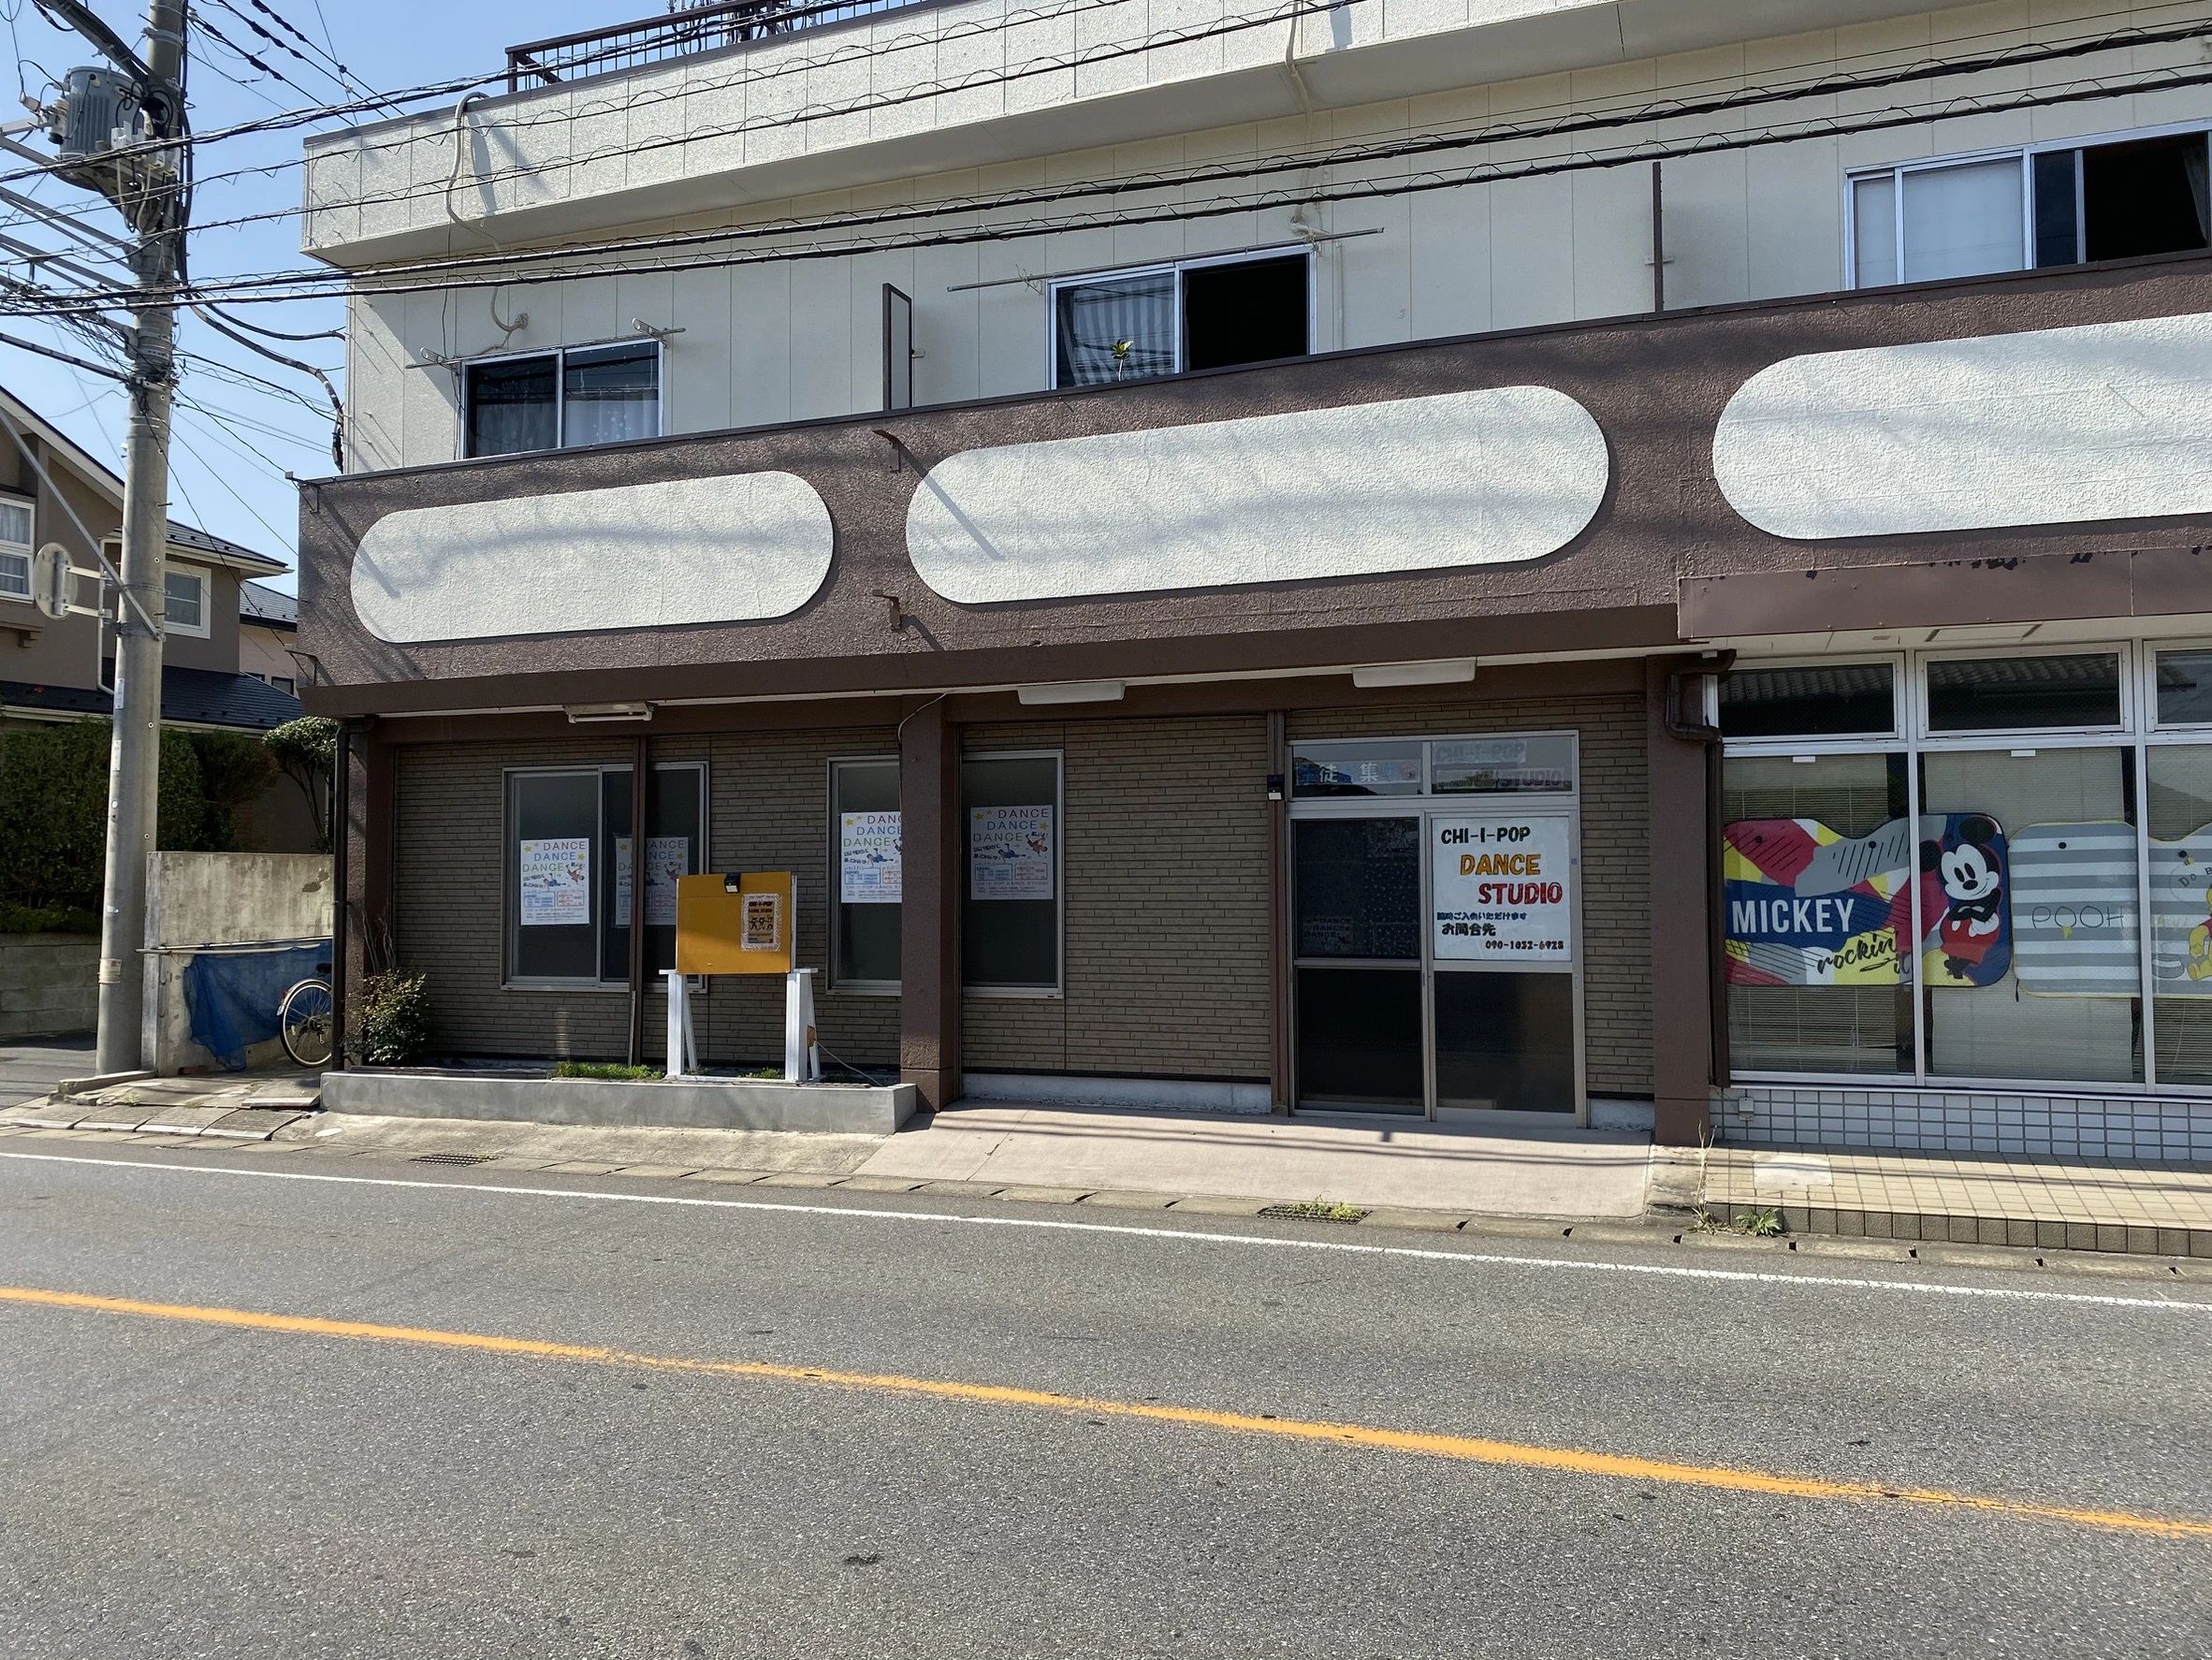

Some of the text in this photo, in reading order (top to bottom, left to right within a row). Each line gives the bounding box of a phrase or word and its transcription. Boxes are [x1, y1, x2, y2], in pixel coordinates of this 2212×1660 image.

[998, 808, 1049, 819] DANCE
[987, 820, 1039, 831] DANCE
[973, 832, 1023, 842] DANCE
[1440, 826, 1532, 845] CHI-I-POP
[543, 840, 586, 852] DANCE
[649, 839, 685, 850] ANCE
[843, 837, 891, 848] DANCE
[533, 852, 576, 862] DANCE
[522, 862, 565, 873] DANCE
[1460, 853, 1542, 877] DANCE
[1477, 881, 1564, 906] STUDIO
[1732, 897, 1855, 935] MICKEY
[2031, 905, 2124, 930] POOH
[1441, 923, 1497, 937] お問合先
